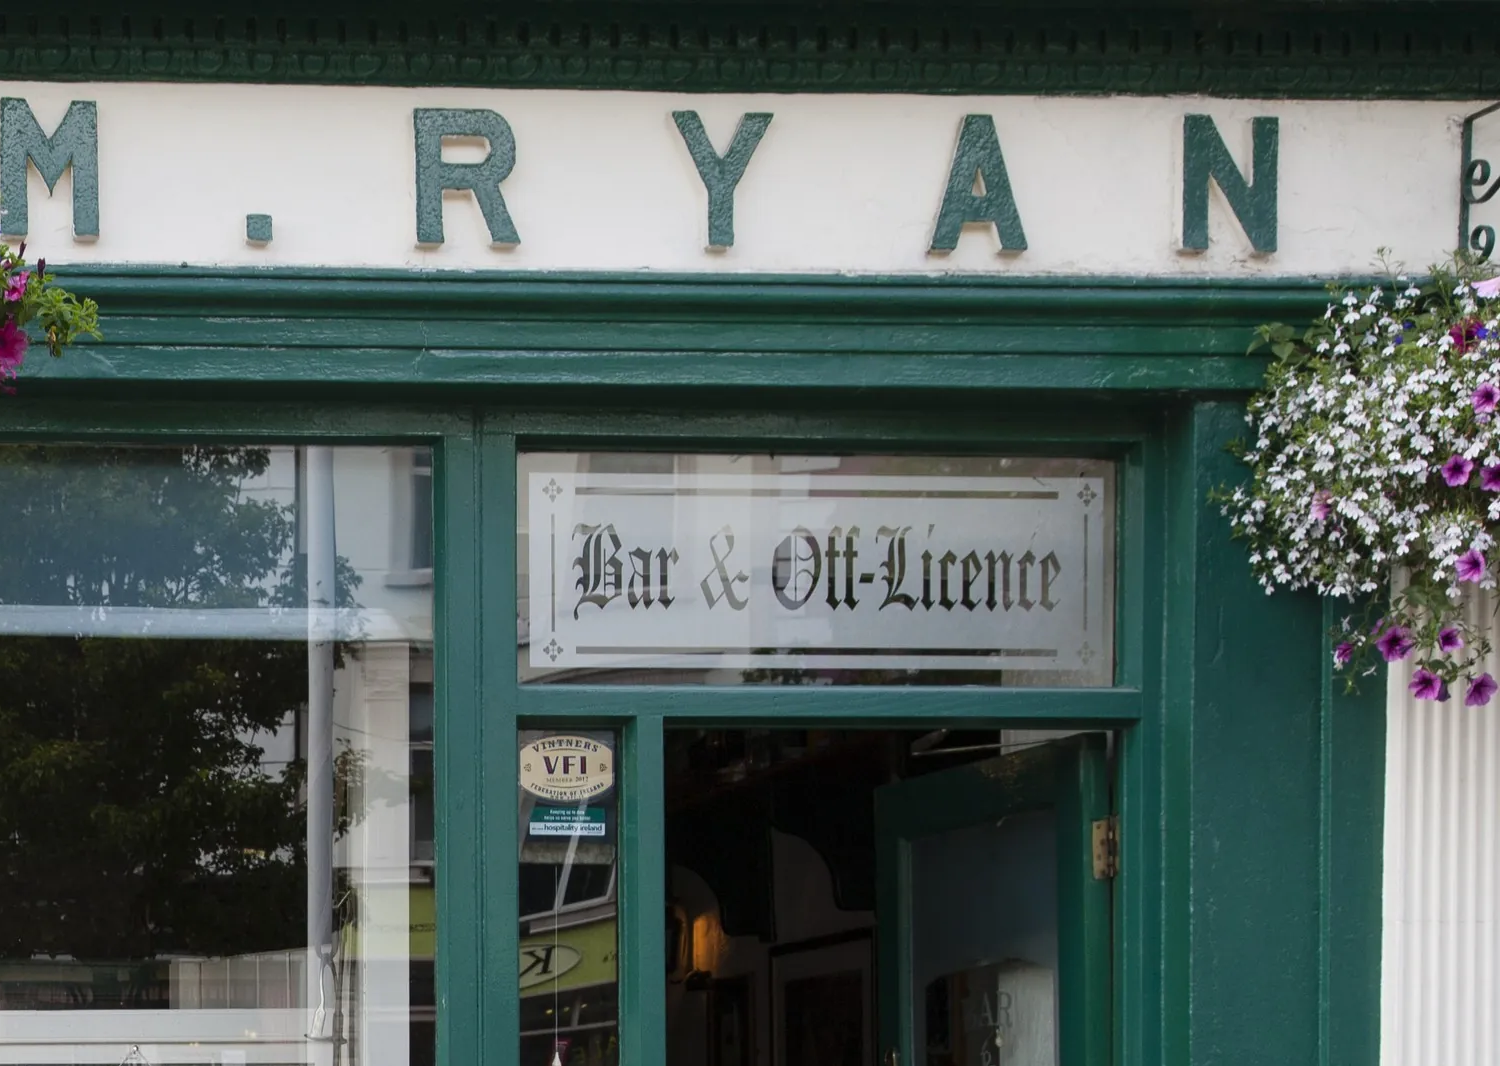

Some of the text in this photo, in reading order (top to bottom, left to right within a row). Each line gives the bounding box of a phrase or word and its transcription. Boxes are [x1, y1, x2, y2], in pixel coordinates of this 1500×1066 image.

[571, 522, 1063, 621] Bar & Off-Licence
[543, 756, 587, 775] VFI
[530, 783, 567, 797] FEDERATION
[544, 824, 578, 832] hospitality
